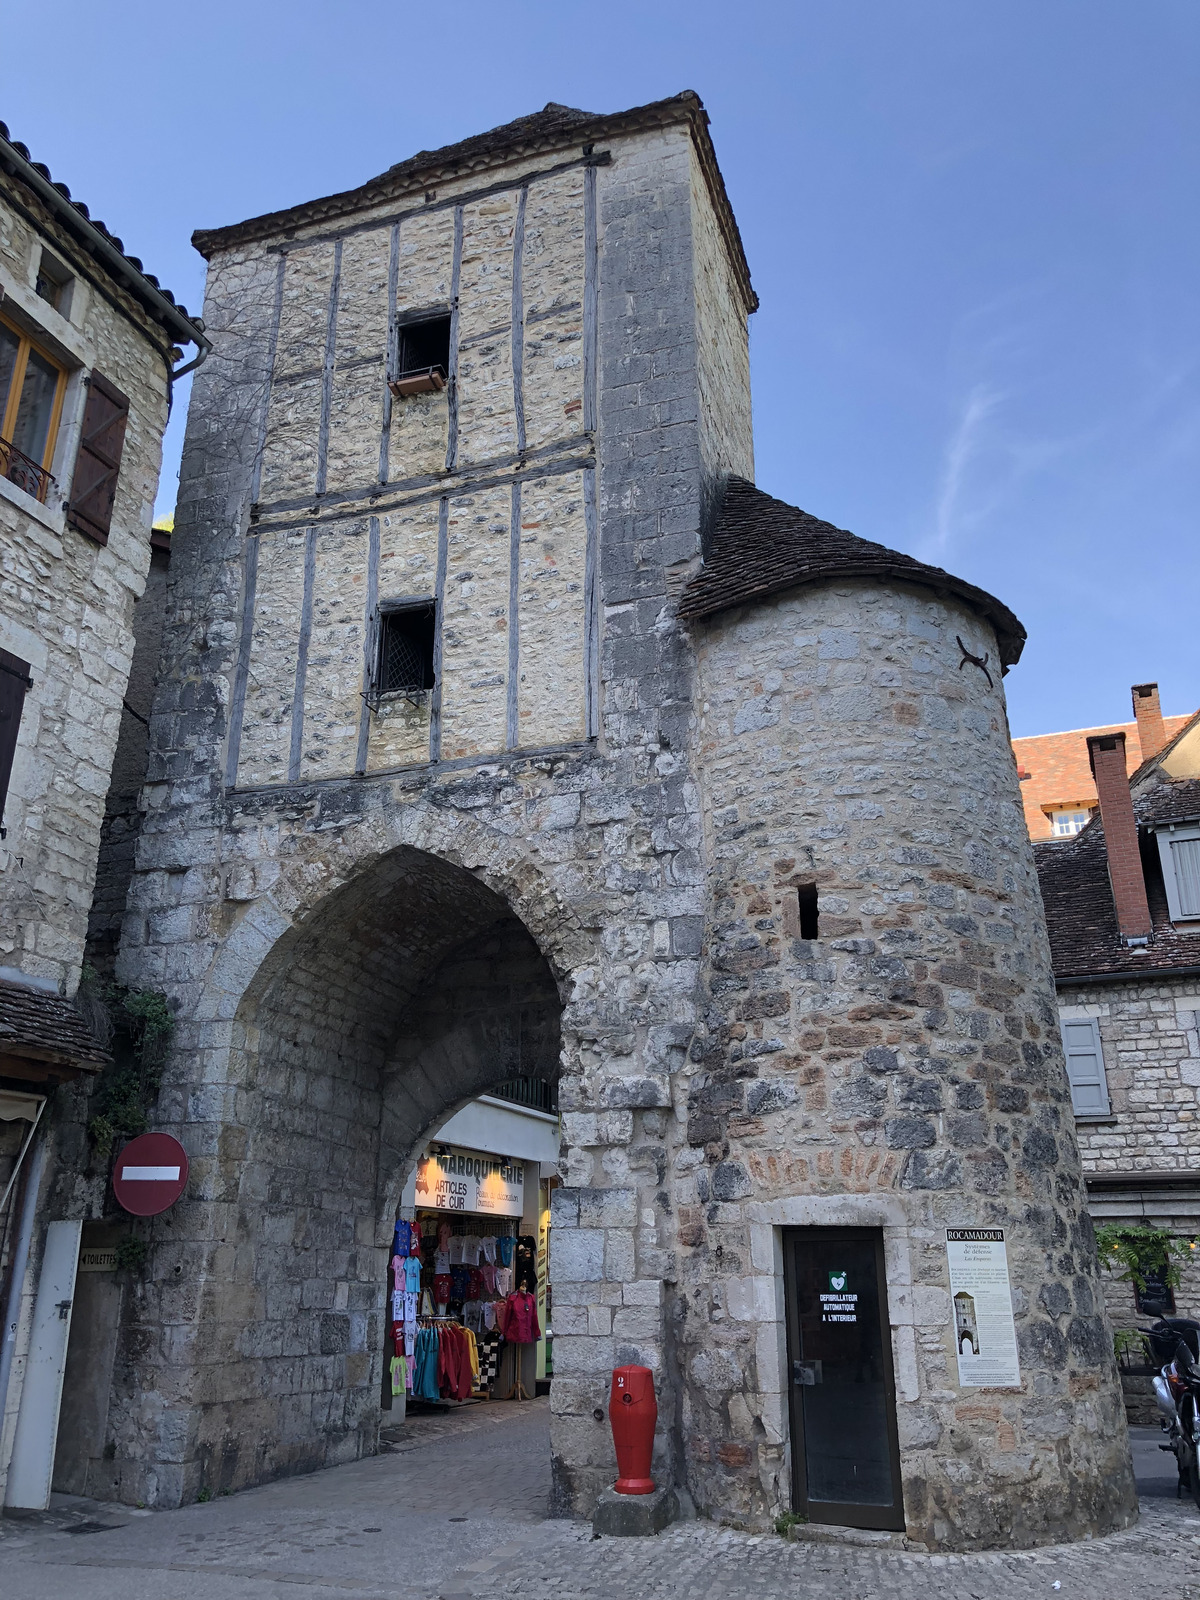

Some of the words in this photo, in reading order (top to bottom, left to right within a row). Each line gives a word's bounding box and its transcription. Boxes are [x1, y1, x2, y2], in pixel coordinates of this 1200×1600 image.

[436, 1154, 523, 1185] MAROQUINERIE
[435, 1180, 467, 1196] ARTICLES
[436, 1194, 446, 1208] DE
[449, 1196, 465, 1210] CUIR
[948, 1230, 1003, 1240] ROCAMADOUR
[87, 1254, 117, 1264] TOILETTES
[819, 1294, 858, 1302] DEFIBRILLATEUR
[823, 1303, 855, 1312] AUTOMATIQUE
[822, 1314, 827, 1322] A
[827, 1314, 857, 1322] L'INTERIEUR
[617, 1376, 624, 1387] 2
